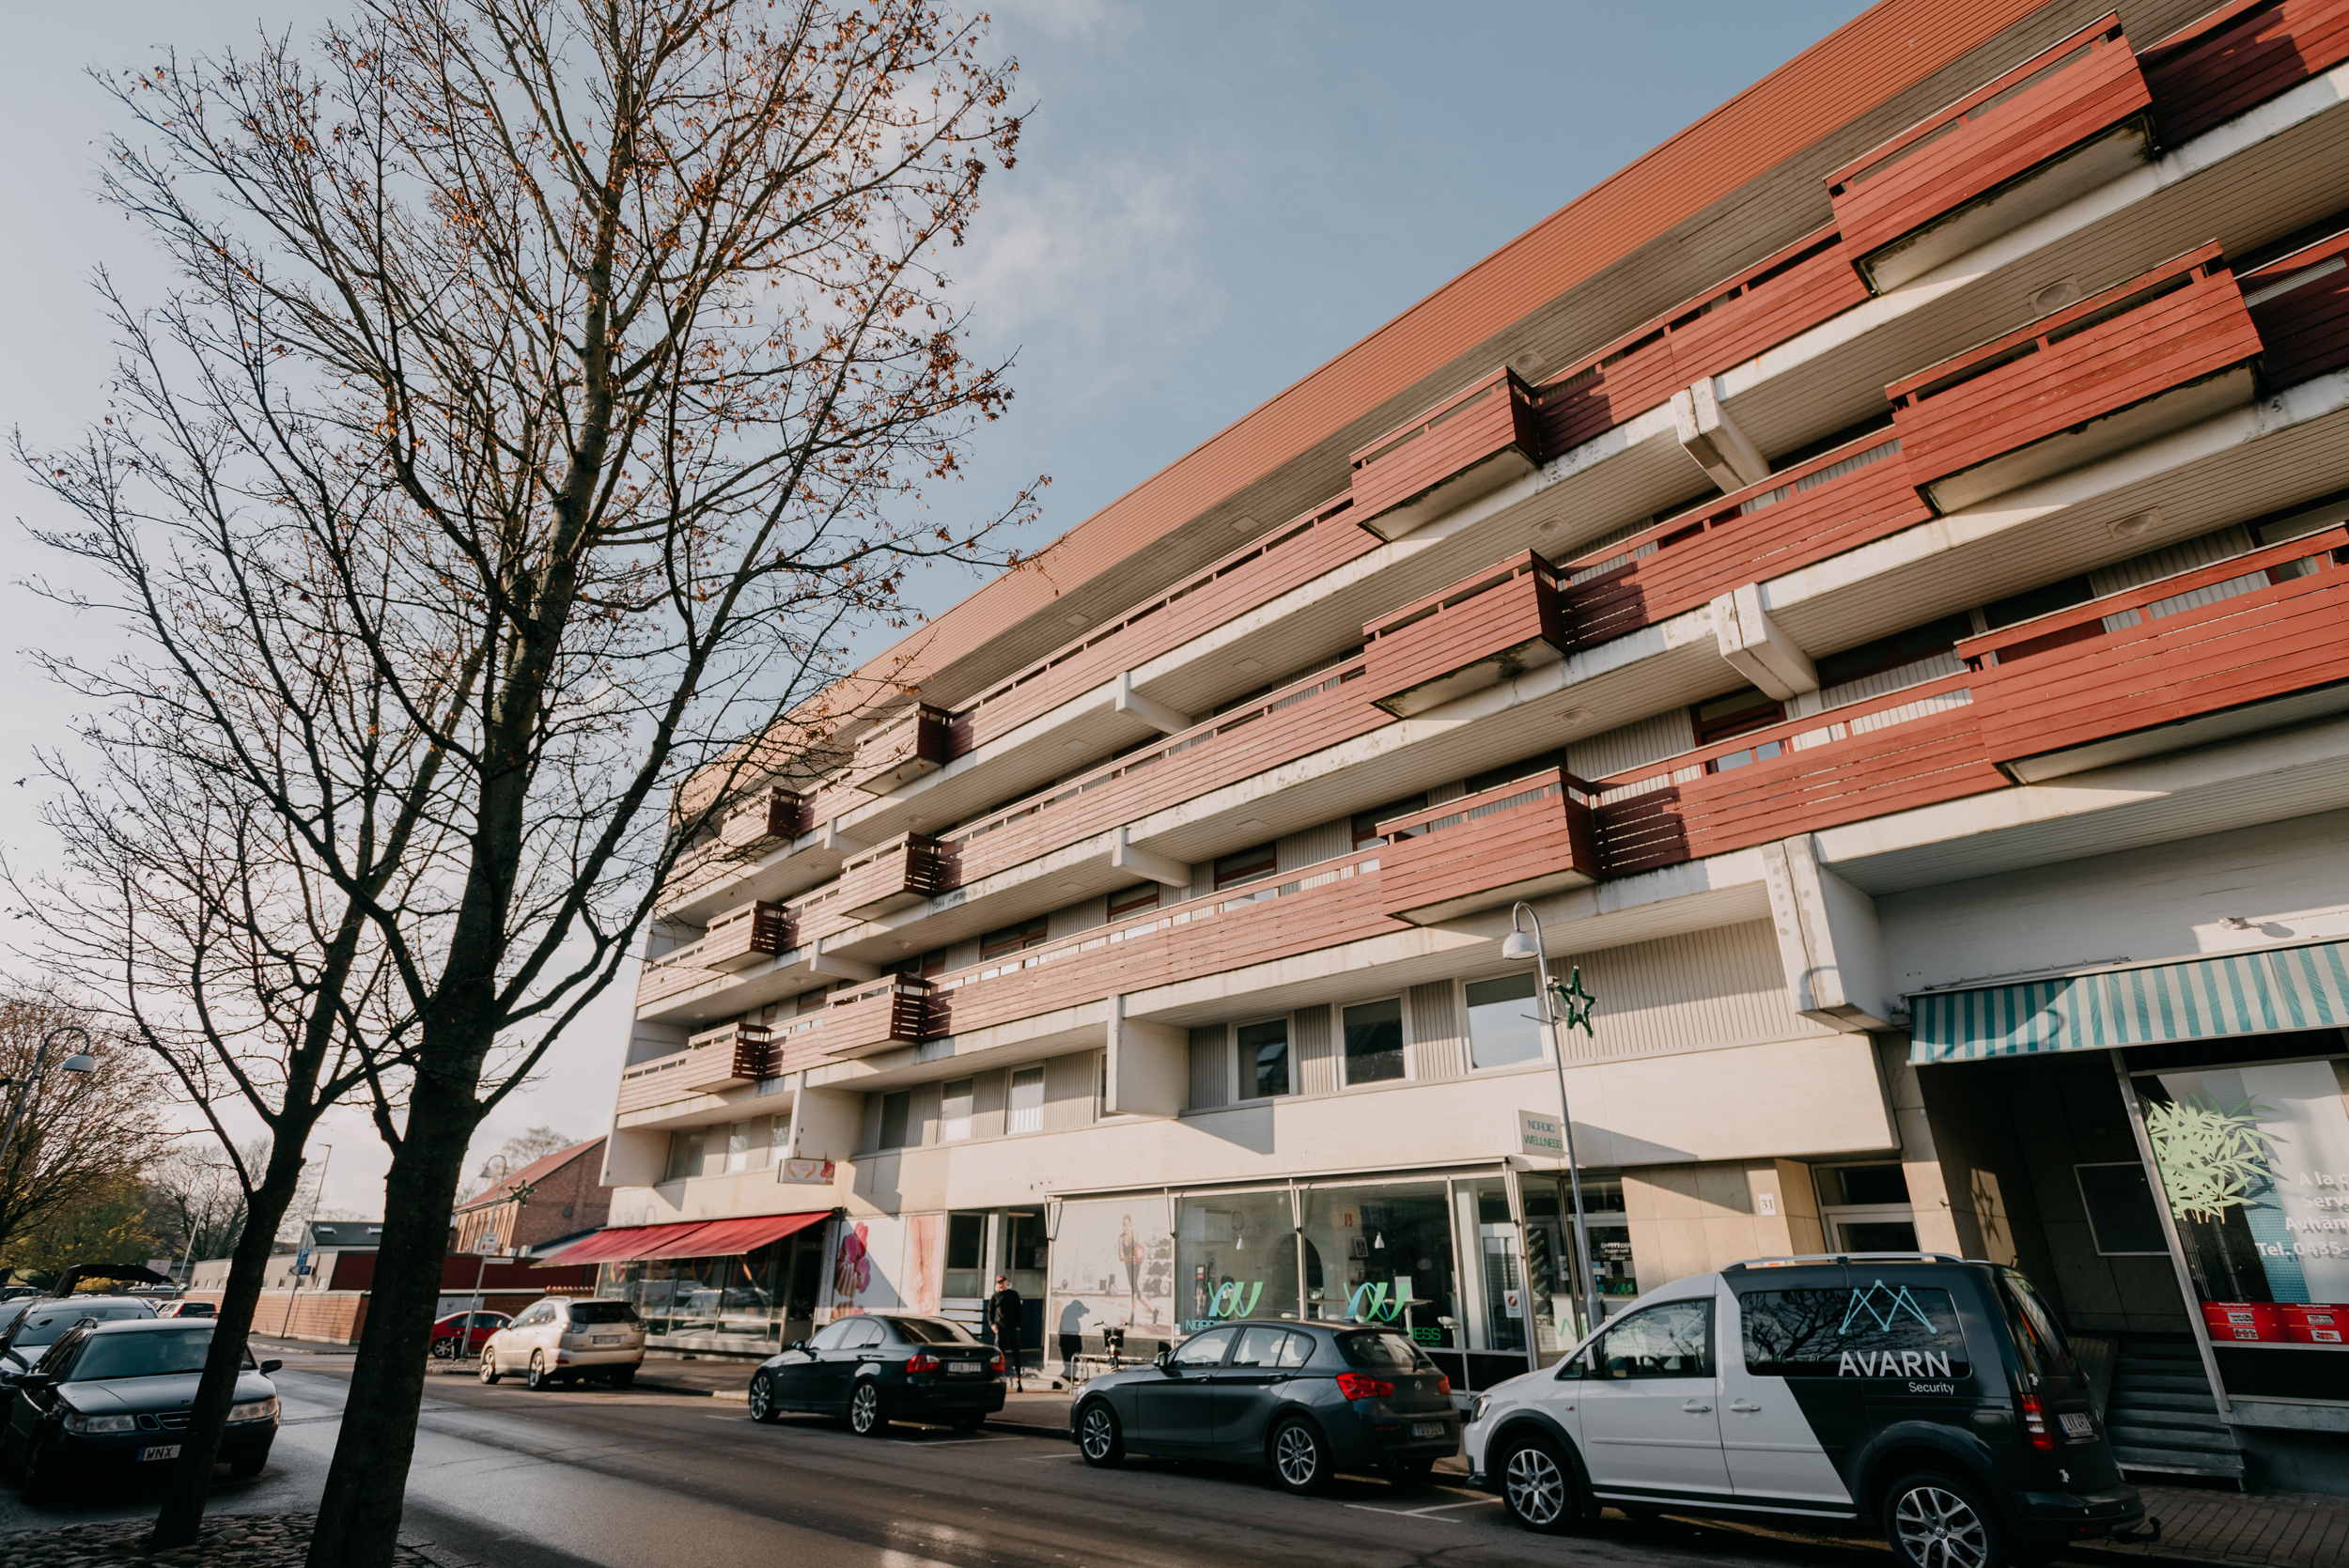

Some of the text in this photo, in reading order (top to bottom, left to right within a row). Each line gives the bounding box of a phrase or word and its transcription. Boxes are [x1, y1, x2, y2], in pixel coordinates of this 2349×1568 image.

[1527, 1119, 1555, 1133] NORDIC
[1523, 1134, 1563, 1149] WELLNESS
[2314, 1171, 2334, 1186] la
[1761, 1199, 1773, 1210] 31
[2255, 1242, 2349, 1256] Tel. 0435-
[1838, 1351, 1952, 1377] AVARN
[1908, 1381, 1954, 1395] Security
[146, 1447, 174, 1459] WNX
